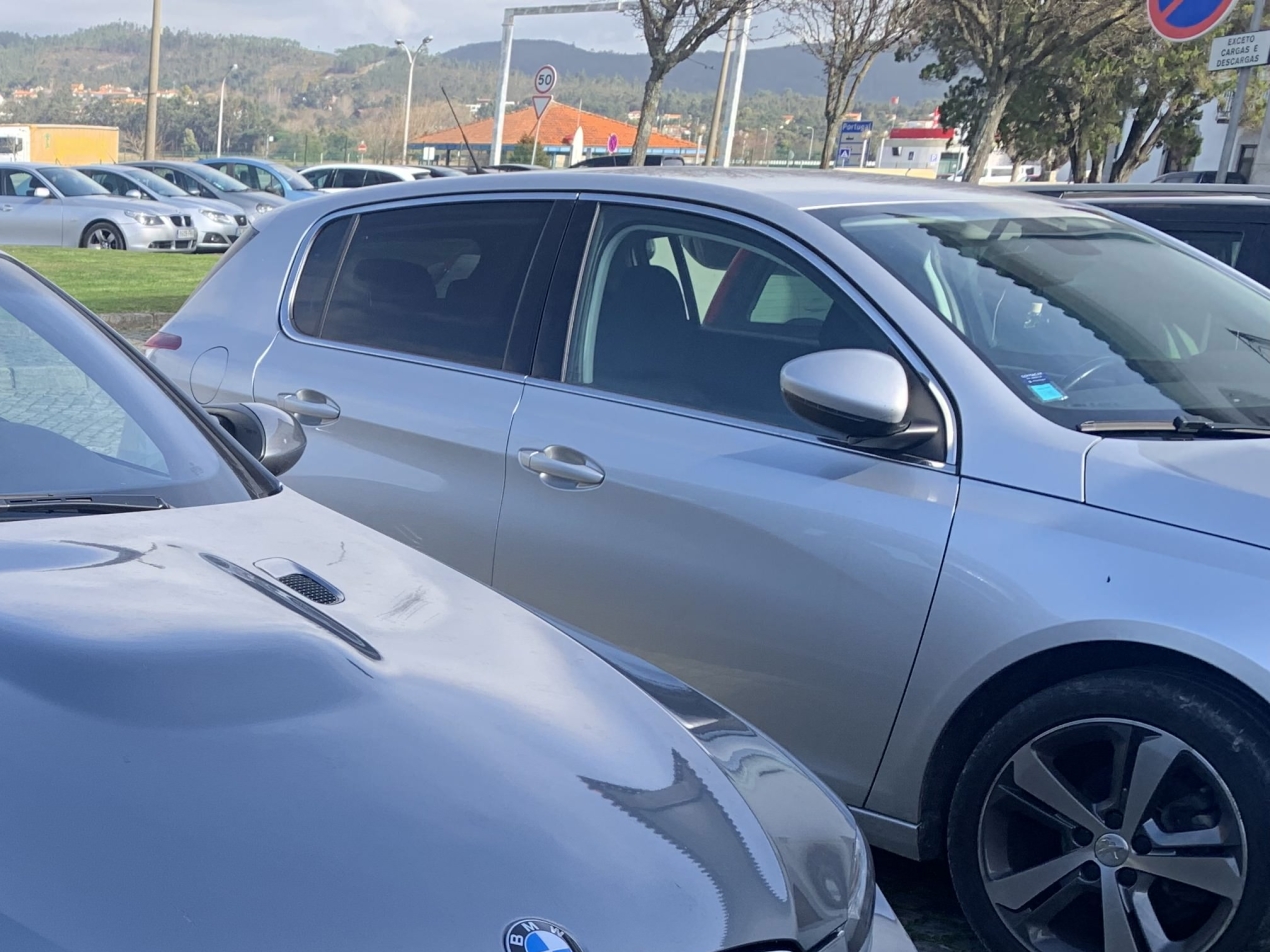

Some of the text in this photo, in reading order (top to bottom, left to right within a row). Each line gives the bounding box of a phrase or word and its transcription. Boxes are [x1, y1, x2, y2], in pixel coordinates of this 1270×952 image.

[1228, 35, 1255, 46] EXCETO
[1220, 44, 1259, 57] CARGAS E
[1216, 55, 1260, 67] DESCARGAS
[538, 74, 552, 86] 50
[842, 122, 872, 132] Portugal
[509, 921, 565, 947] BMW
